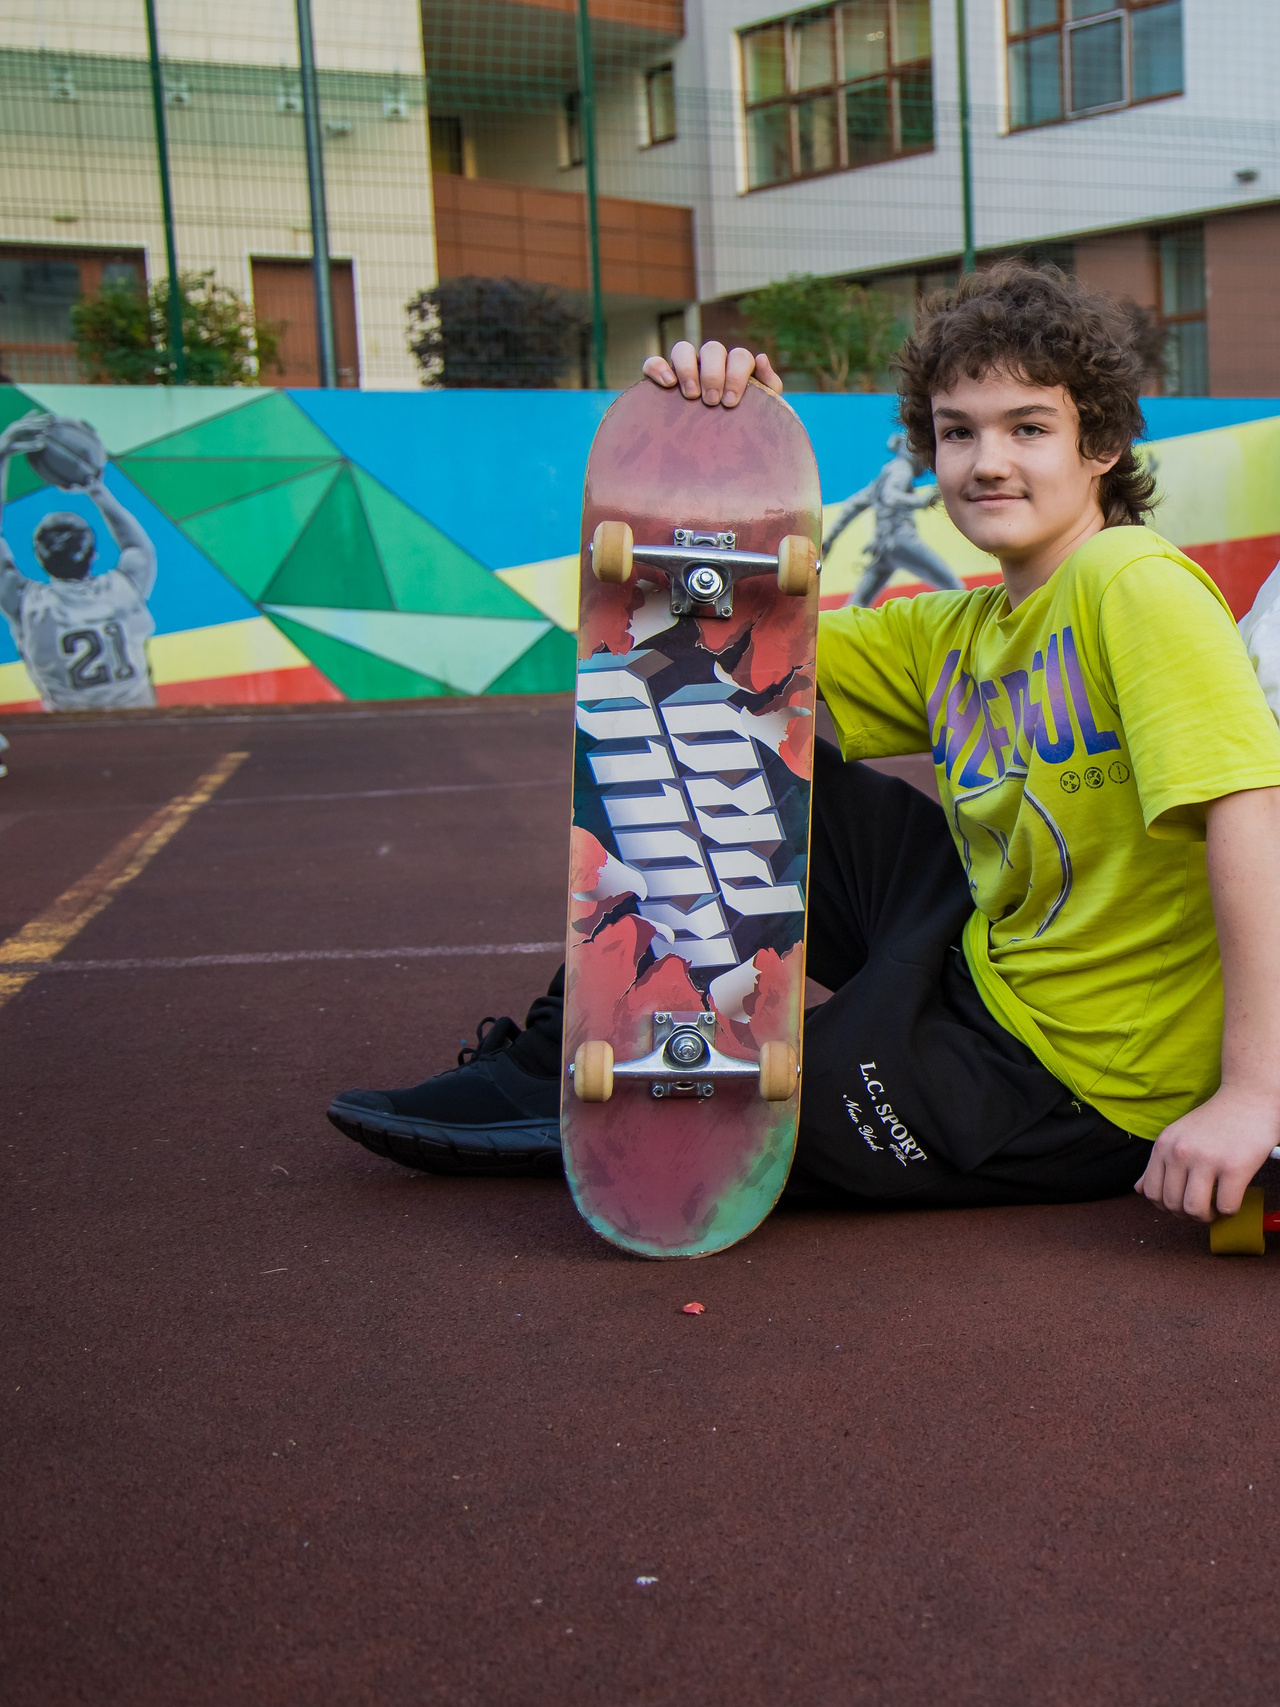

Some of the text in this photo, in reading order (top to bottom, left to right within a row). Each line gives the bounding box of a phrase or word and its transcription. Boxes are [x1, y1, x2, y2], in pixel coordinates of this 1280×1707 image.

[62, 622, 135, 690] 21
[658, 686, 806, 917] PRO
[858, 1061, 885, 1101] L.C.
[874, 1103, 928, 1161] SPORT
